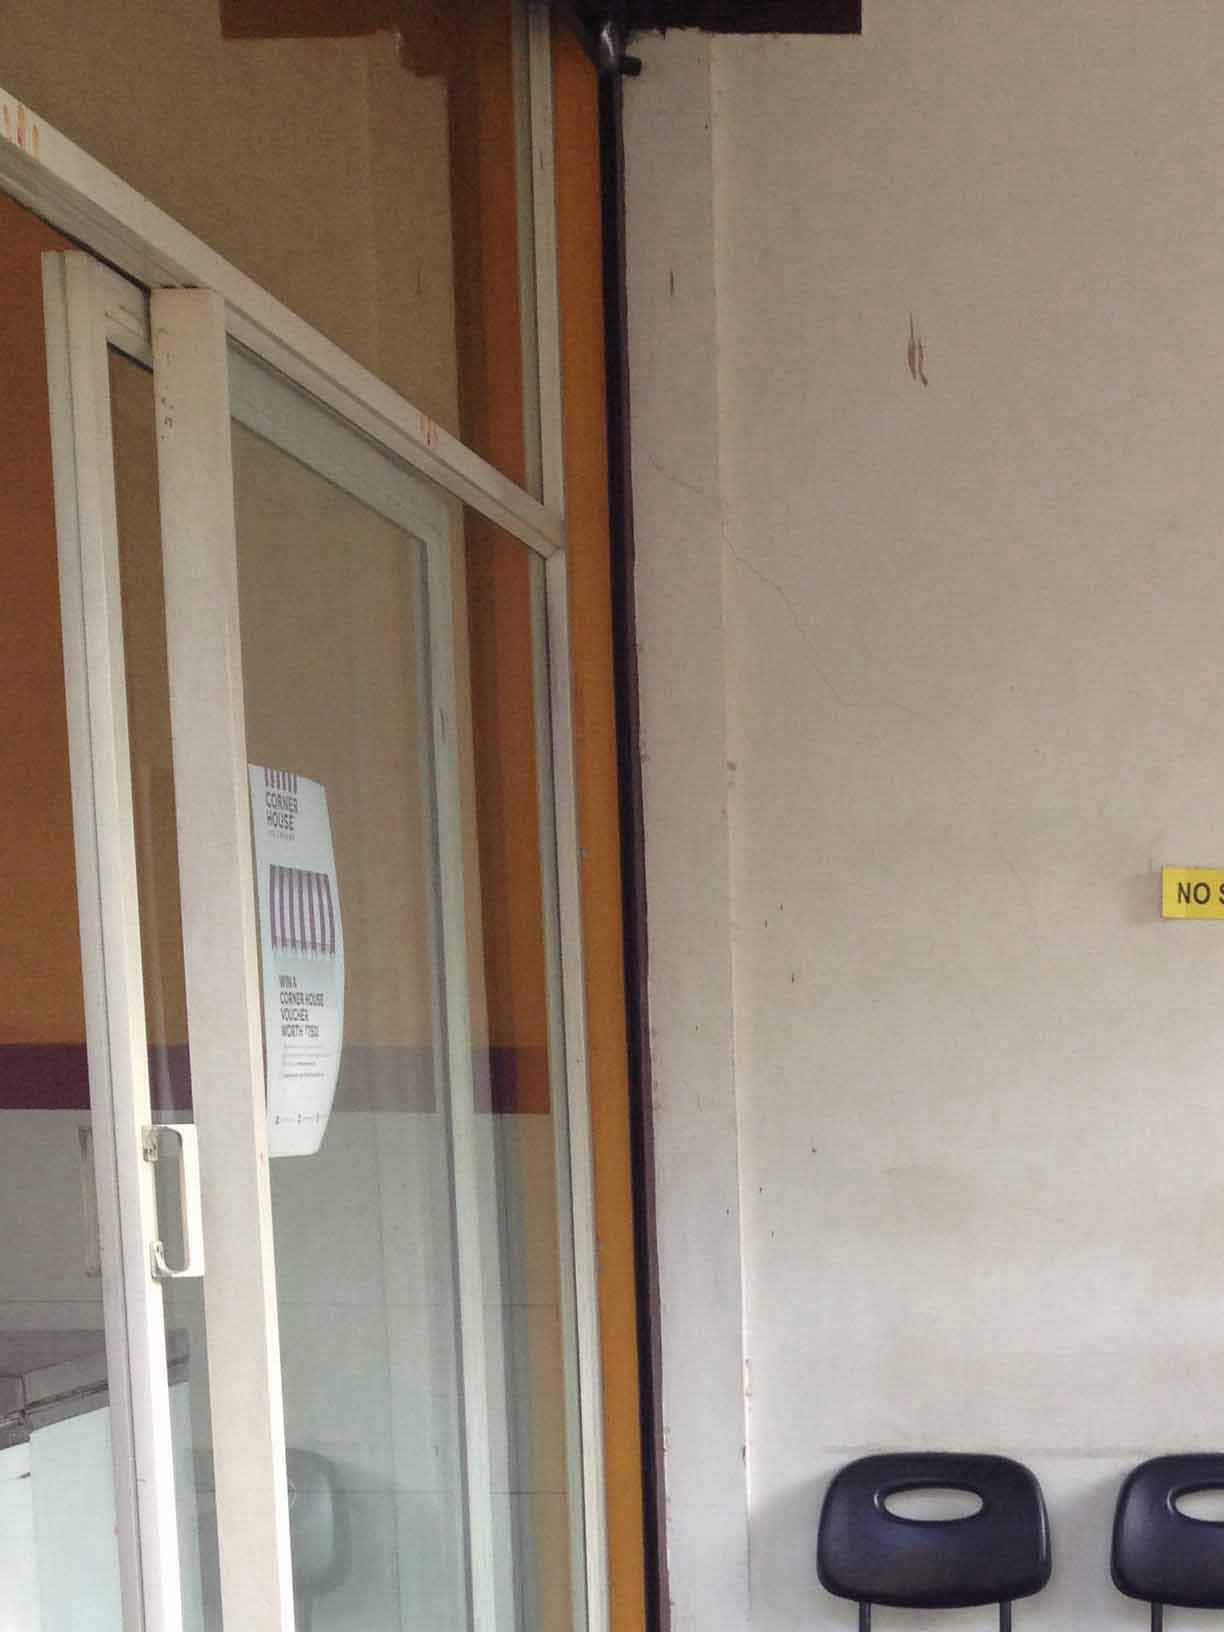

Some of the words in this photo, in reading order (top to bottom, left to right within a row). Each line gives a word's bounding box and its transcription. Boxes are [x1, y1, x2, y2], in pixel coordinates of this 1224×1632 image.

[265, 791, 298, 814] CORNER
[266, 808, 296, 831] HOUSE
[1177, 882, 1211, 905] NO
